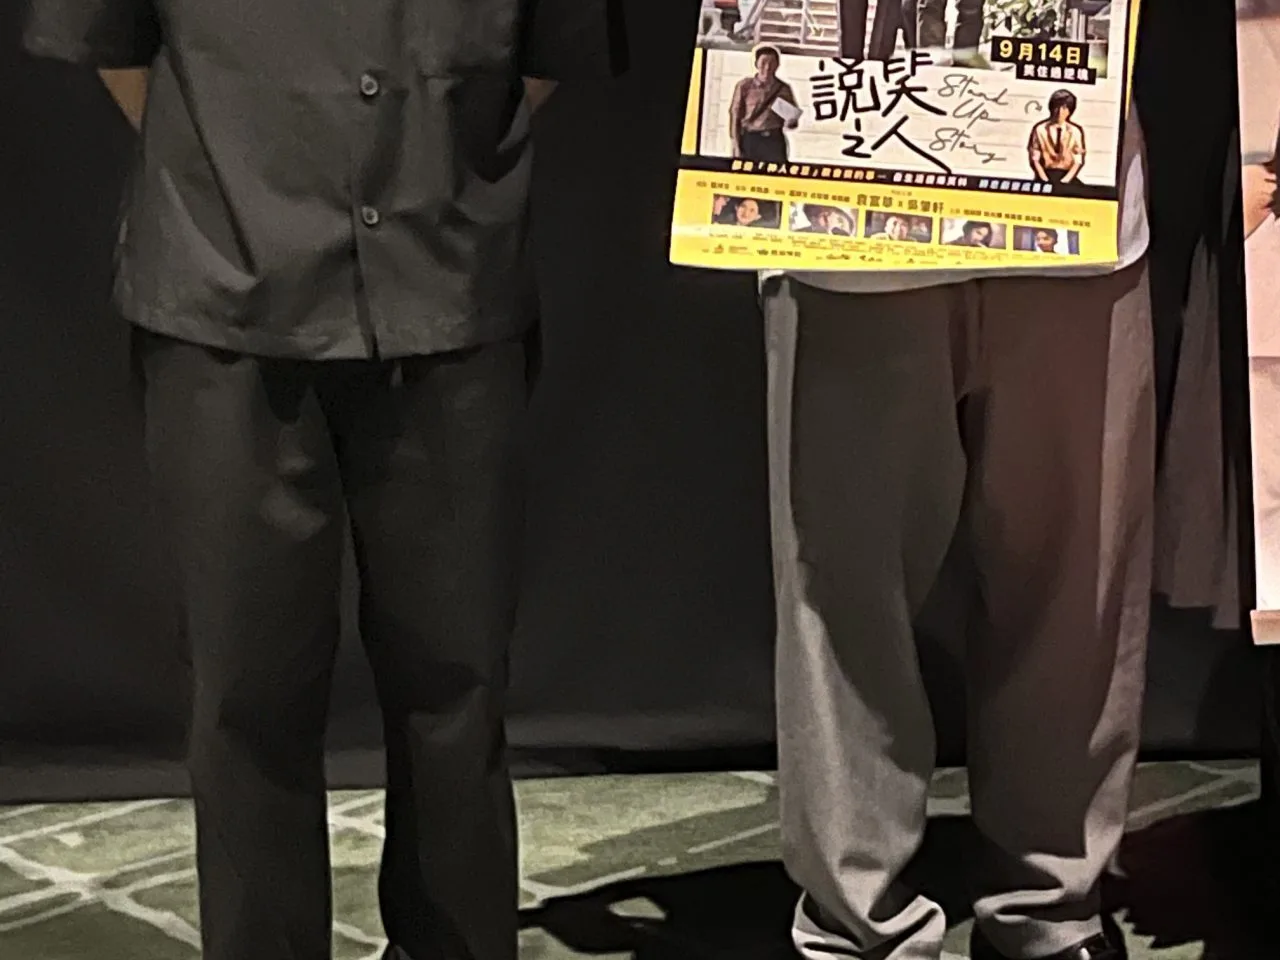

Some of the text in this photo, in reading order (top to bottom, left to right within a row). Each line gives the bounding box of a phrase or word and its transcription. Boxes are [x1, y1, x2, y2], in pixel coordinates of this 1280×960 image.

[999, 39, 1081, 65] 9月14日
[937, 73, 1009, 107] Stand
[952, 97, 1001, 129] Up
[841, 114, 952, 174] 之人
[929, 127, 1007, 164] Story
